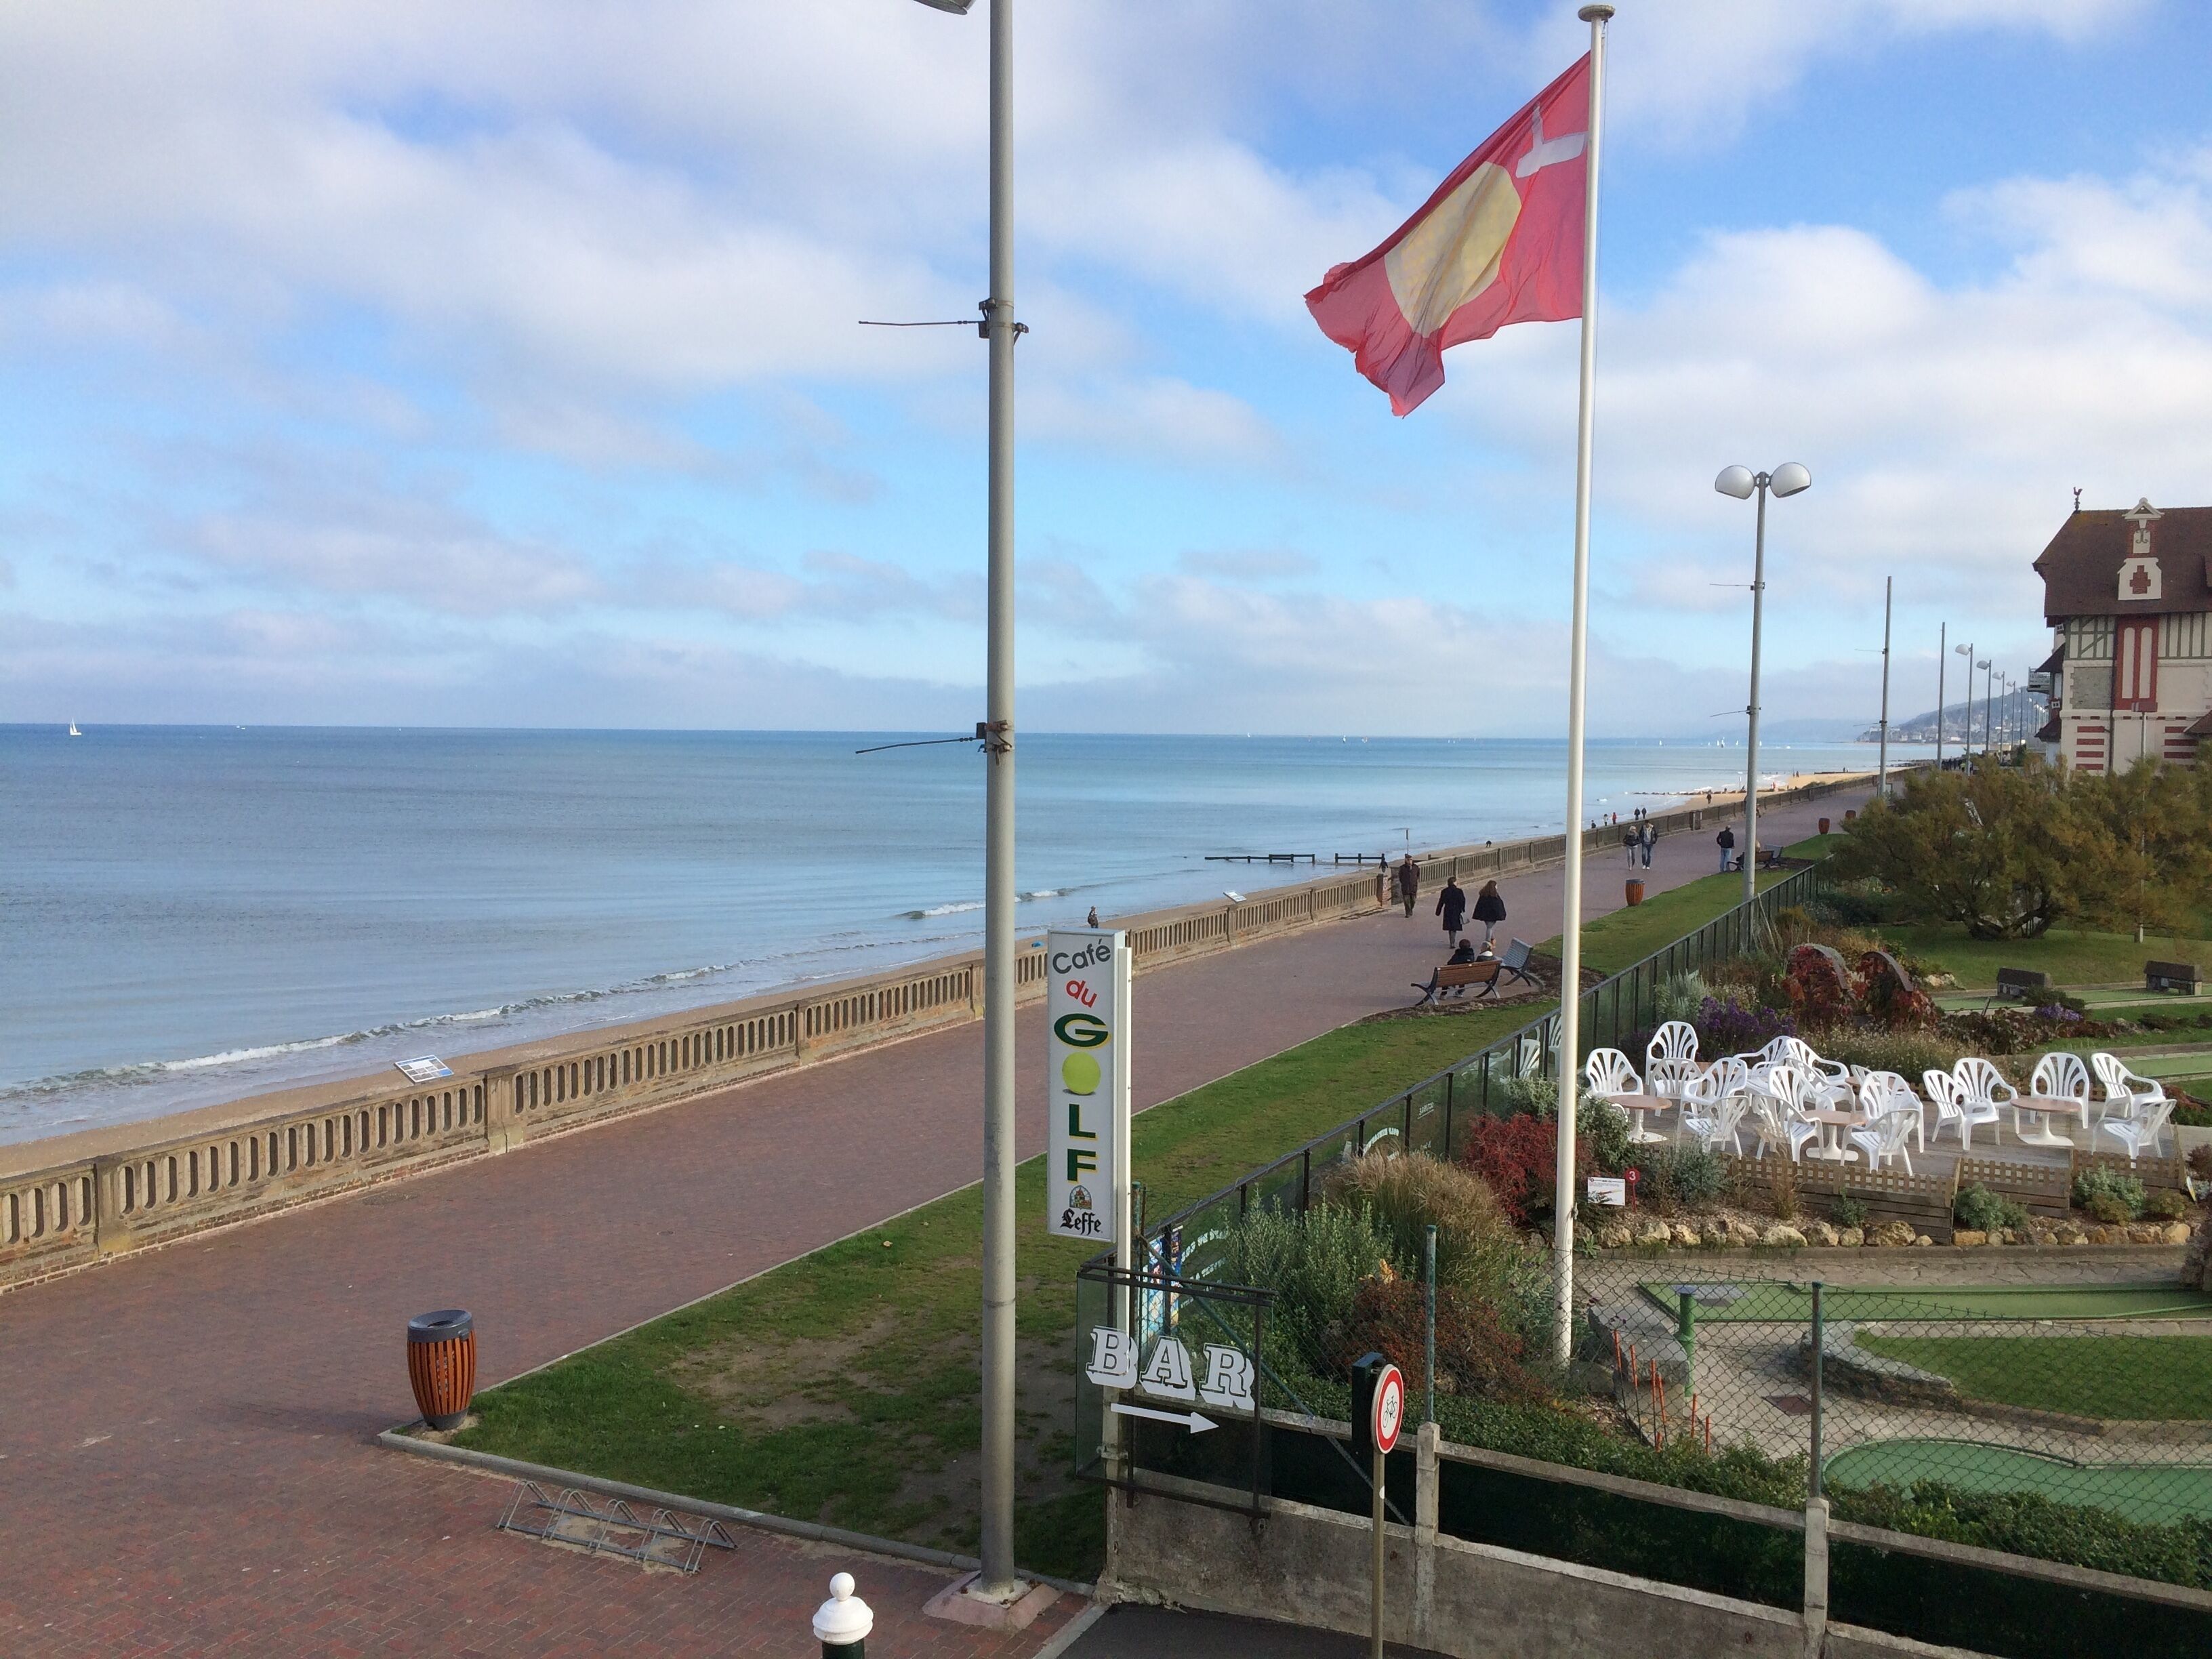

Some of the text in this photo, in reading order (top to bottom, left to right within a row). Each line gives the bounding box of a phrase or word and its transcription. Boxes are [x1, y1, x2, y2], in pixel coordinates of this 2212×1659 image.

[1052, 939, 1111, 974] Café
[1066, 980, 1097, 1008] du
[1629, 1171, 1637, 1181] 3
[1060, 1208, 1102, 1235] Leffe
[1086, 1325, 1255, 1411] BAR
